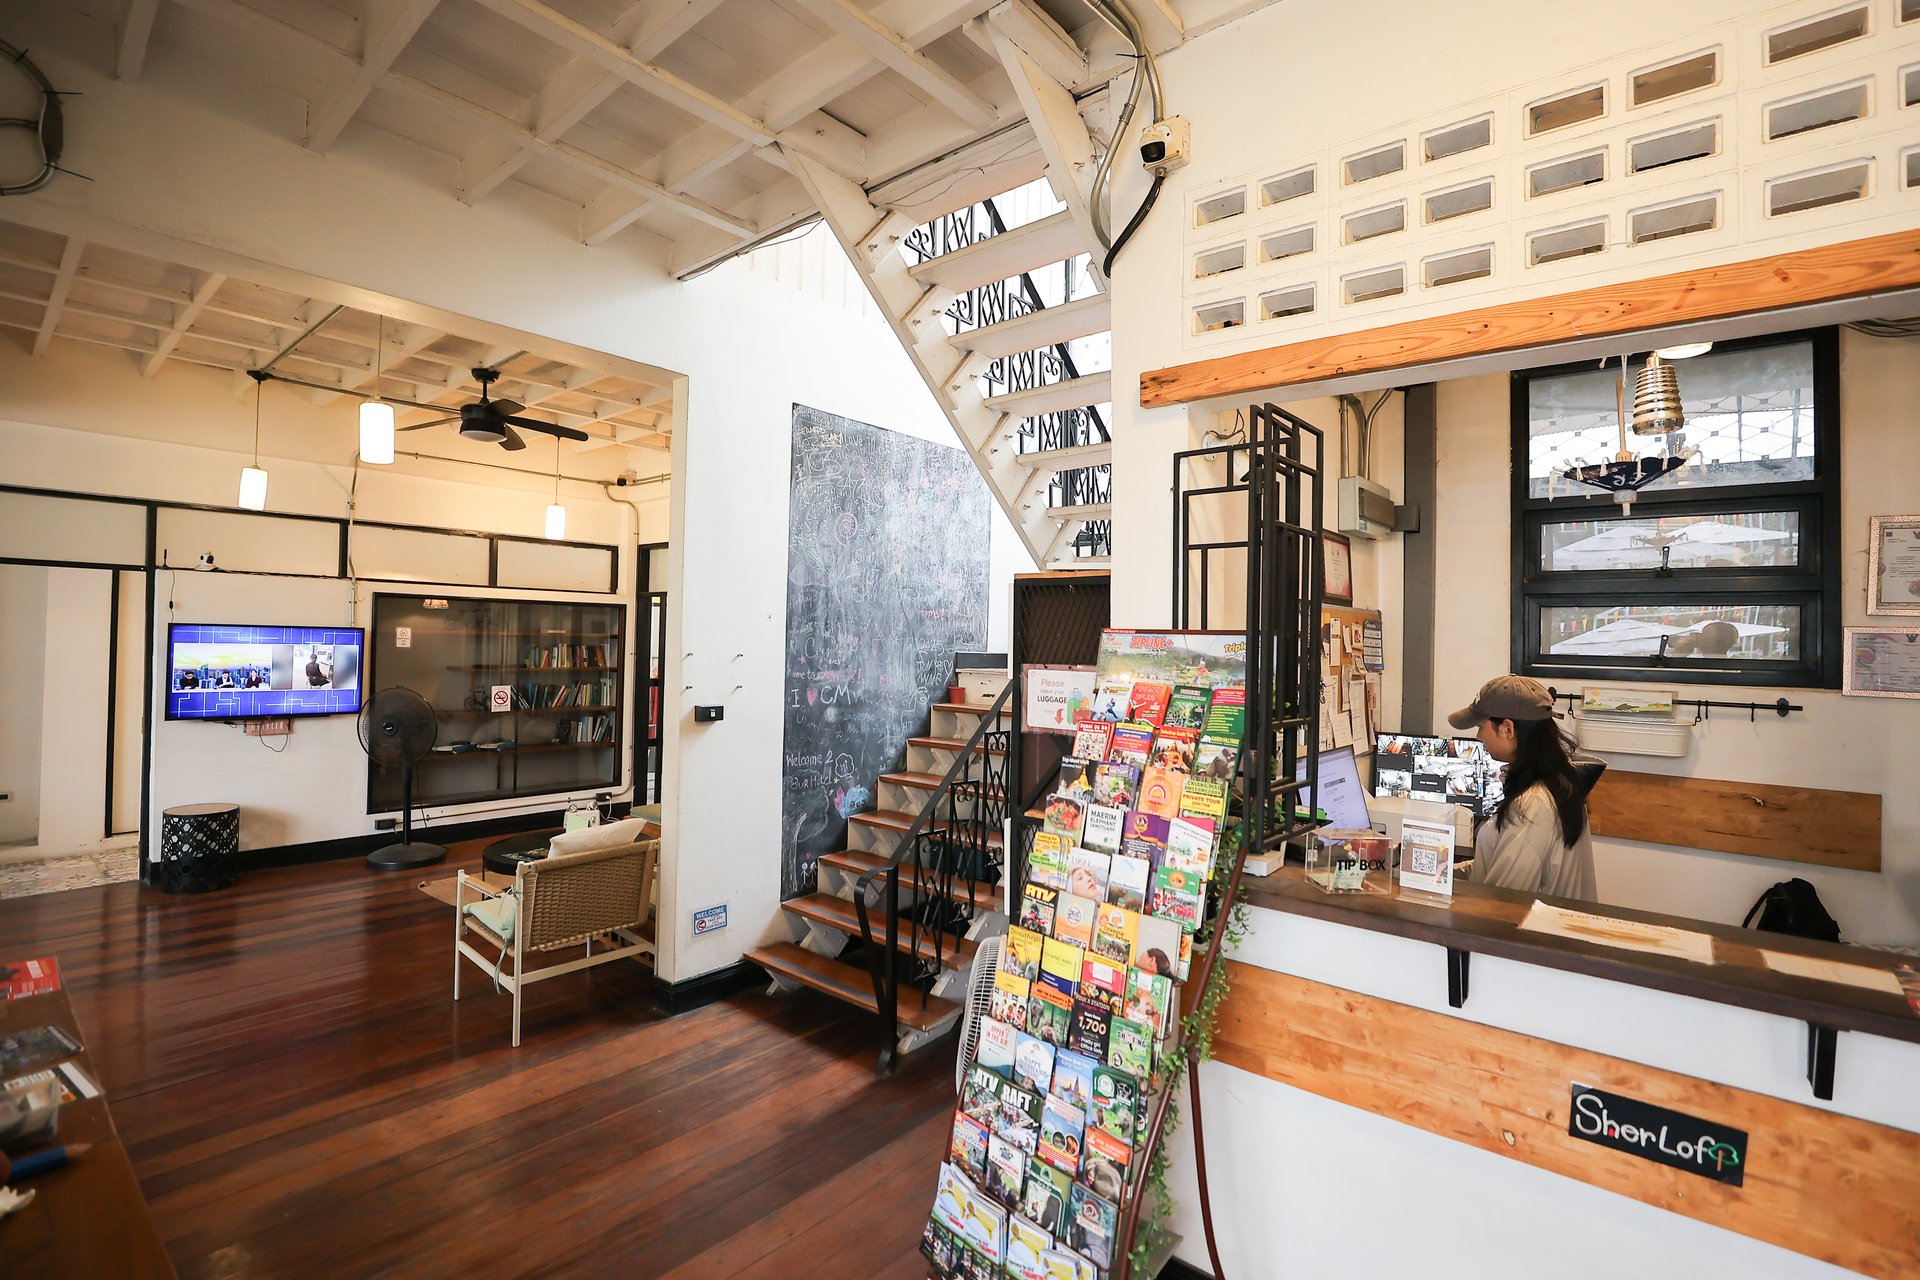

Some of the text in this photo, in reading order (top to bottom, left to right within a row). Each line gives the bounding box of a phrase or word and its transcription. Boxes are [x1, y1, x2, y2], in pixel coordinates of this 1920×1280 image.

[1040, 678, 1065, 687] Please
[791, 684, 851, 708] I CM
[1037, 695, 1068, 704] LUGGAGE
[250, 721, 284, 731] NETFLIX
[786, 750, 834, 767] Welcome 2
[810, 766, 833, 787] Hotel
[1183, 793, 1221, 805] PRIVATE TOUR
[1091, 809, 1117, 822] MAERIM
[1089, 823, 1115, 832] SANCTUARY
[1090, 817, 1116, 828] ELEPHANT
[1337, 859, 1386, 872] TIP BOX
[1025, 883, 1057, 903] ATV
[695, 906, 725, 920] WELCOME
[1078, 1015, 1107, 1036] 1,700
[974, 1067, 1000, 1093] ATV
[1001, 1083, 1033, 1112] RAFT
